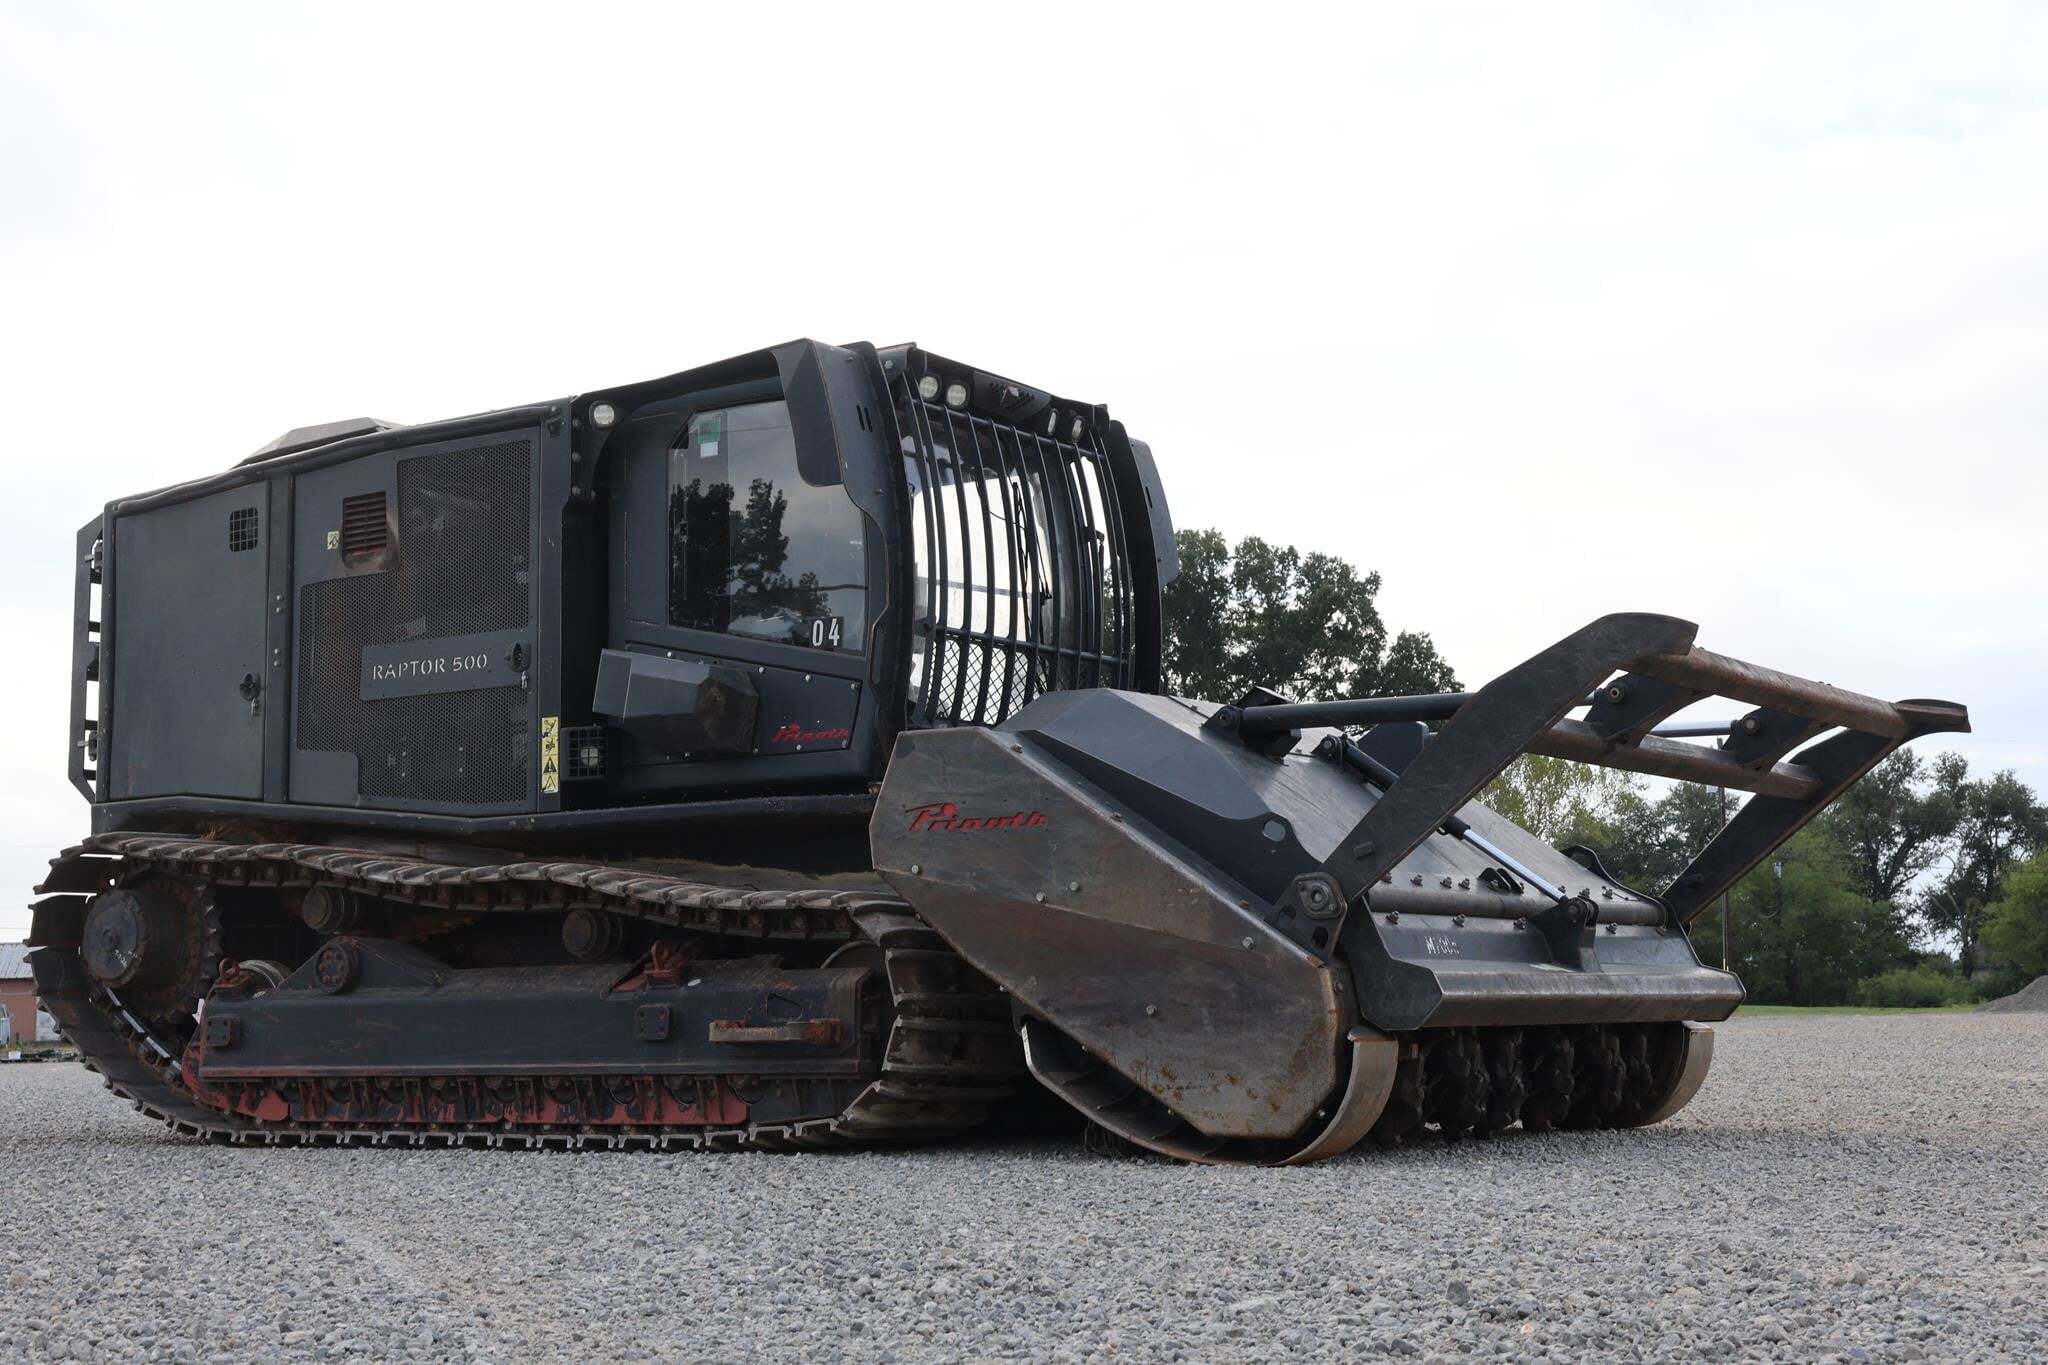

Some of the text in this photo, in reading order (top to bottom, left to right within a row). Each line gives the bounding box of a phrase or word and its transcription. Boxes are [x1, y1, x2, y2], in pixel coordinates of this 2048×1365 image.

[812, 617, 840, 647] 04
[373, 653, 488, 680] RAPTOR 500
[905, 802, 1047, 832] Prinoth
